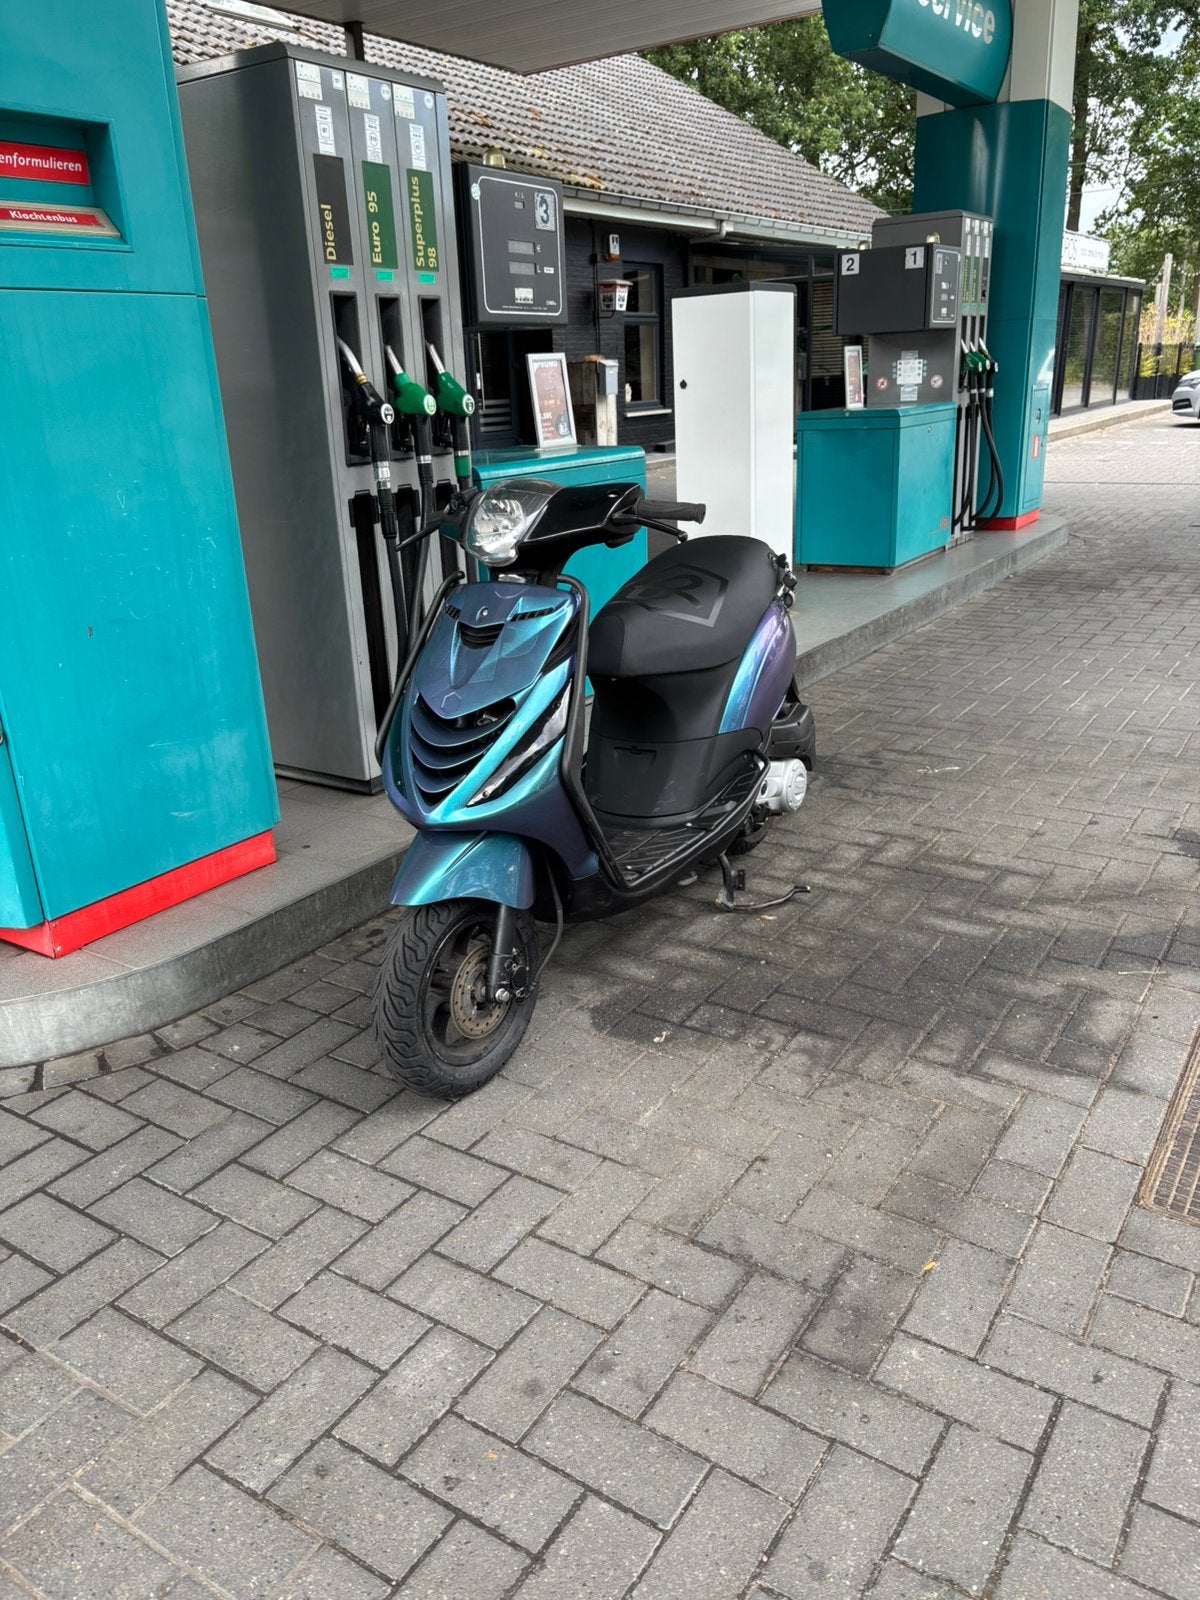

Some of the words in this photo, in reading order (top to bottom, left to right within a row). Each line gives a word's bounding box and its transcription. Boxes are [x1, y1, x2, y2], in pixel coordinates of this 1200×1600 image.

[918, 0, 995, 45] rvice
[0, 152, 82, 172] enformulieren
[367, 191, 379, 213] 95
[539, 195, 550, 224] 3
[9, 210, 78, 223] Klachtenbus
[411, 176, 425, 267] Superplus
[320, 204, 337, 261] Diesel
[372, 221, 382, 264] Euro
[427, 247, 437, 268] 98
[846, 257, 855, 272] 2
[911, 251, 917, 265] 1
